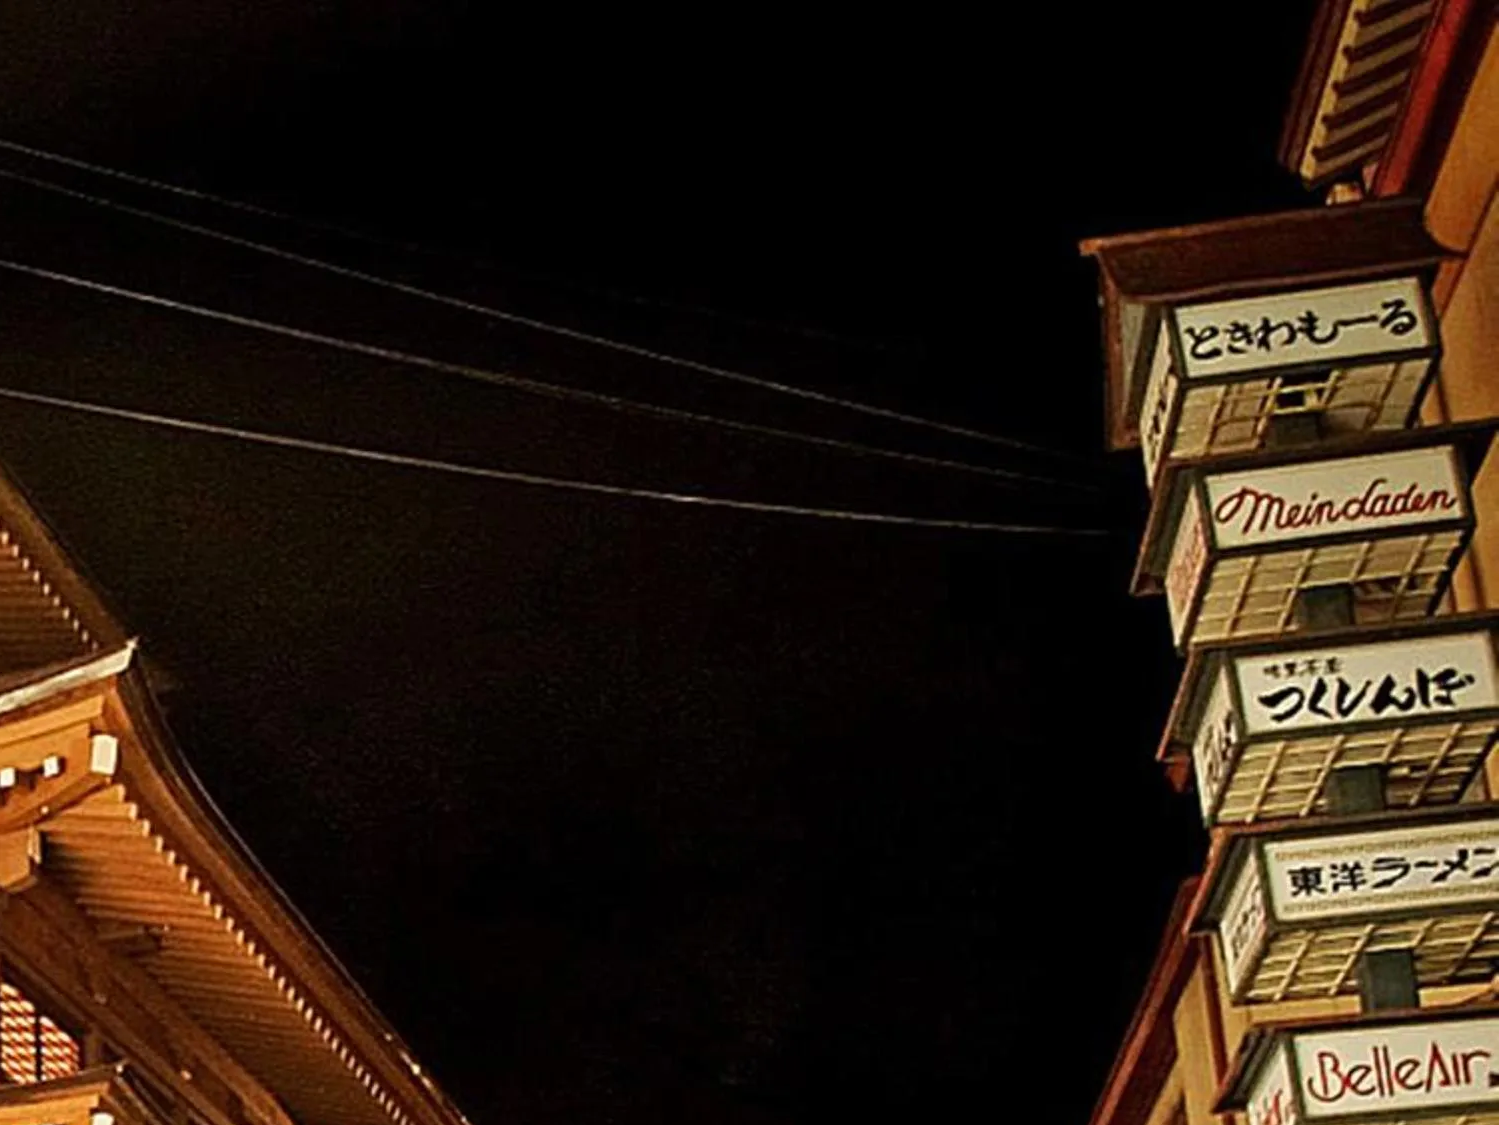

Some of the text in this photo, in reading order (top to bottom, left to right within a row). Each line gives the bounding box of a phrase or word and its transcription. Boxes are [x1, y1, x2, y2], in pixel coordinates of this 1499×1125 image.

[1185, 298, 1417, 359] ときわもーる
[1288, 848, 1499, 896] 東洋ラーメン
